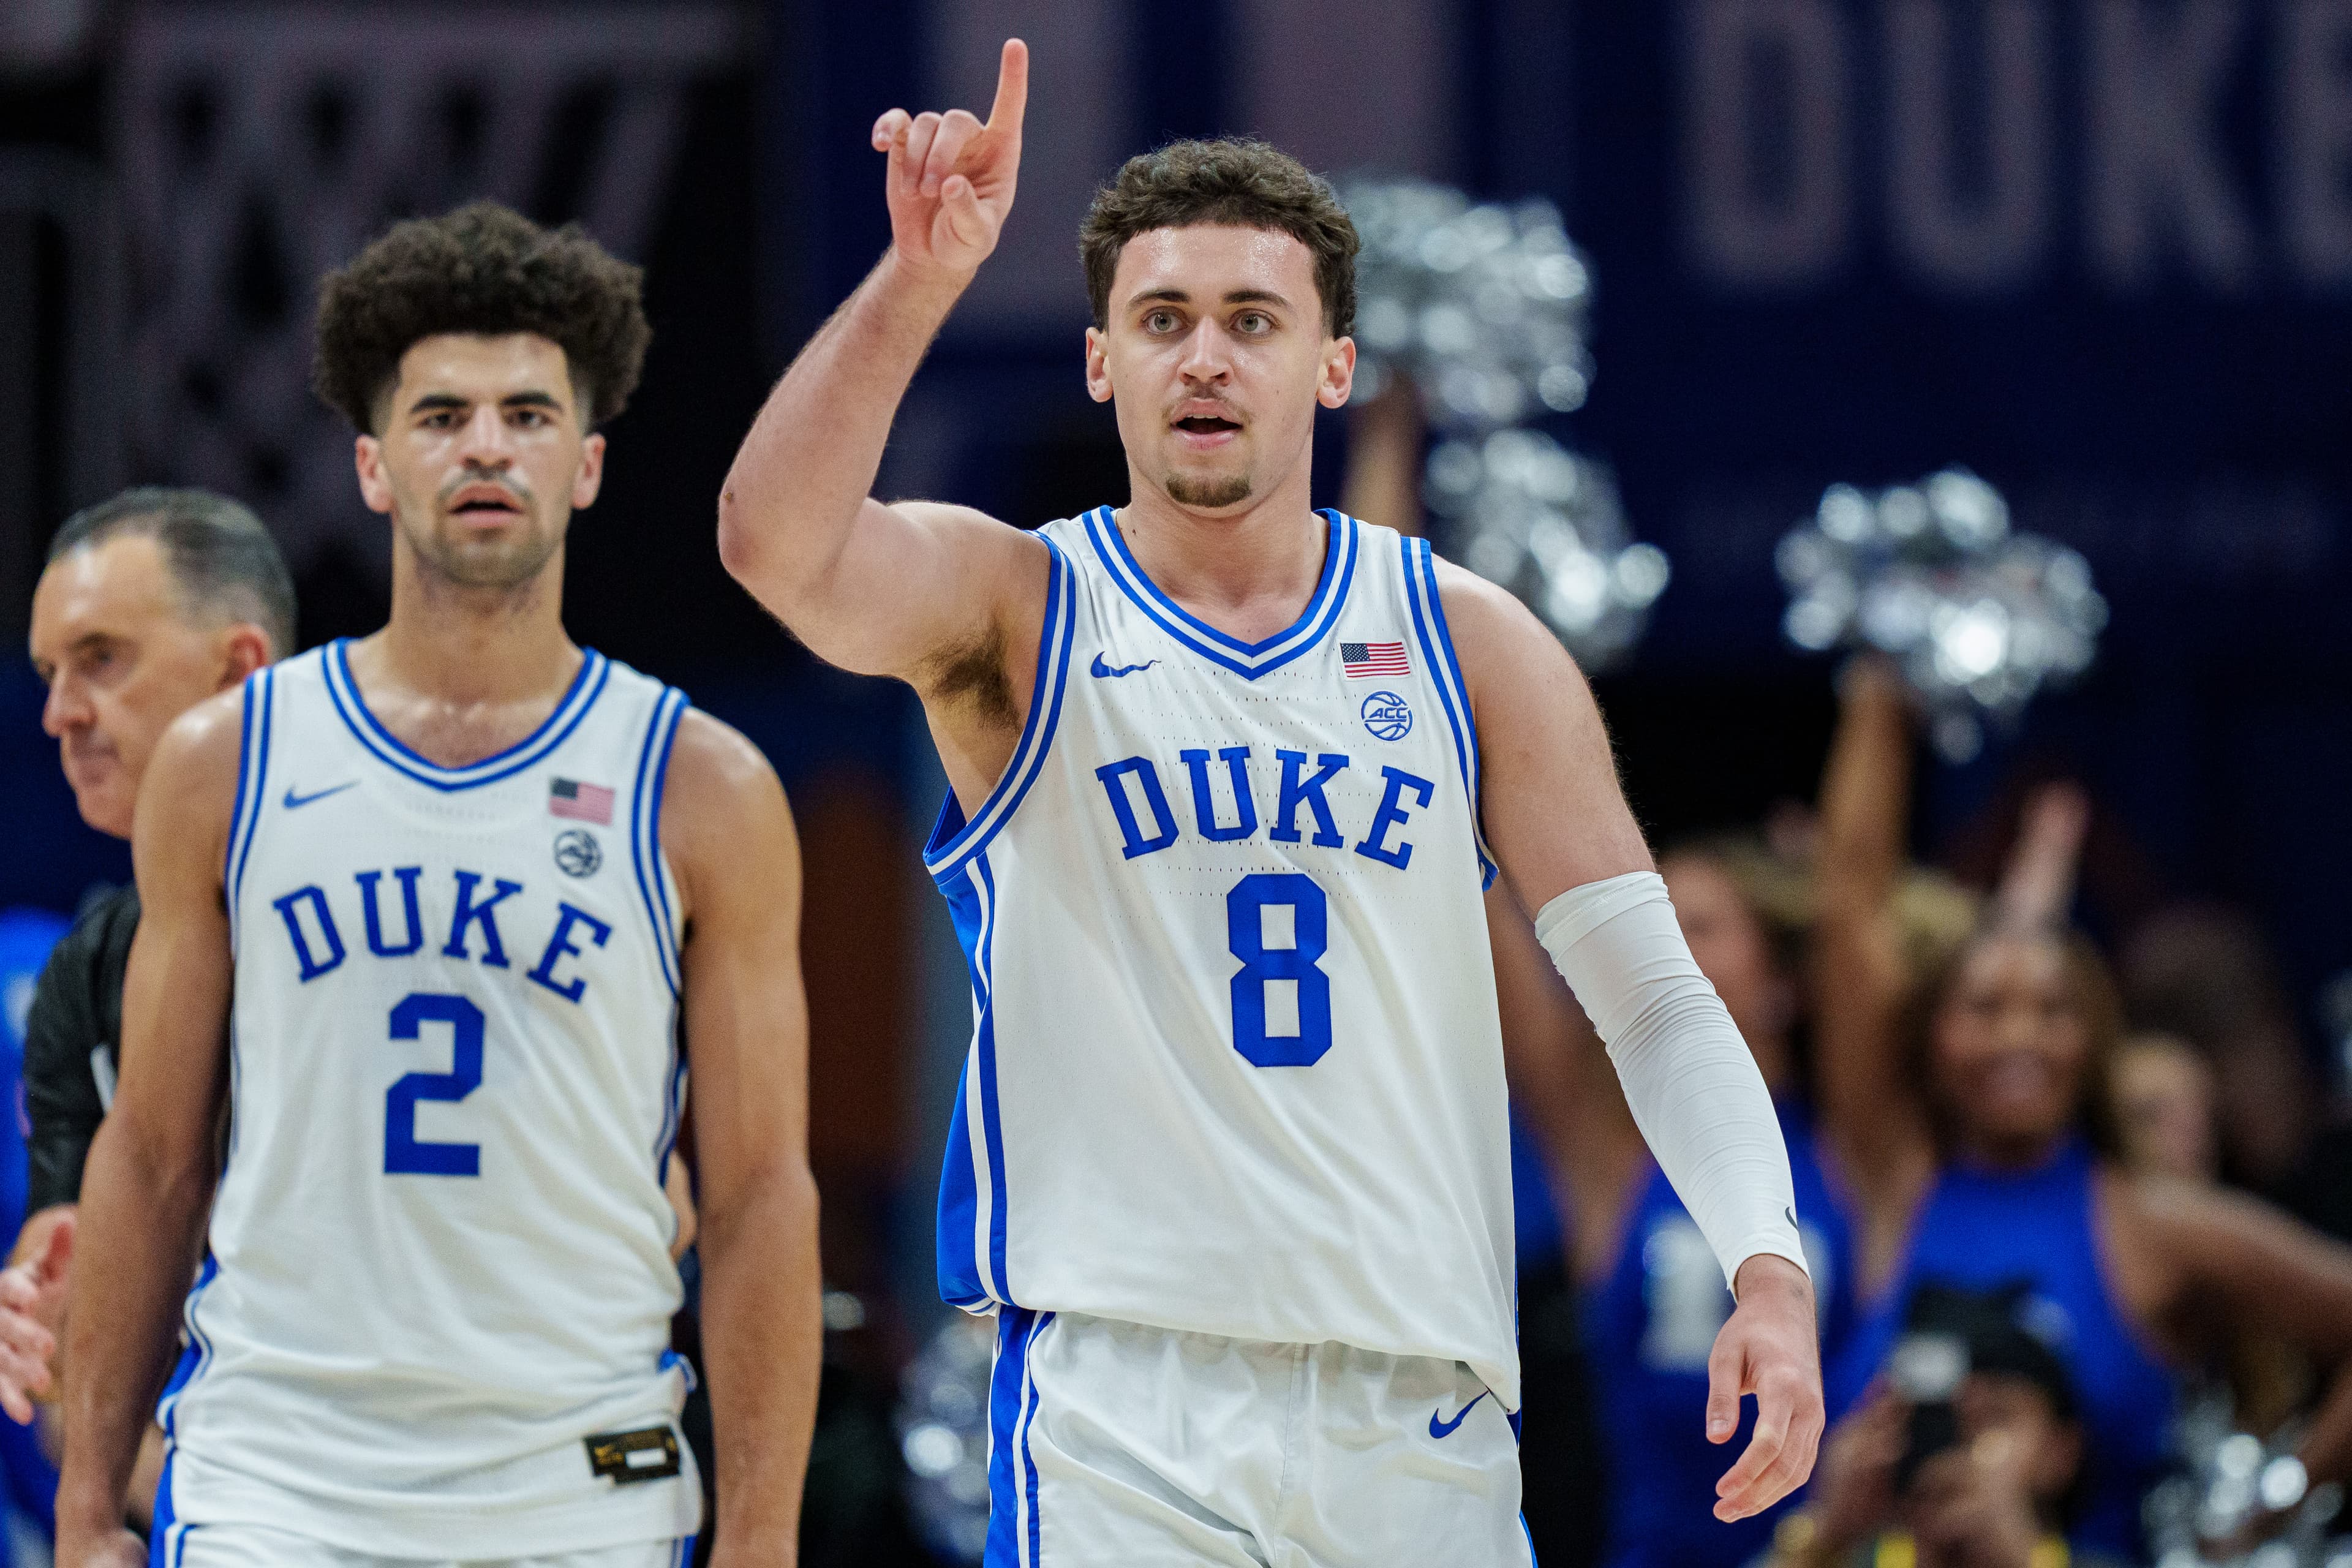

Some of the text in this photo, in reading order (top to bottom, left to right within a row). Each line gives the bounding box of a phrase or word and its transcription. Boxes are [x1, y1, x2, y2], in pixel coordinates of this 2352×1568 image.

[1369, 706, 1408, 719] ACC
[1095, 745, 1435, 870] DUKE
[272, 865, 612, 1003] DUKE
[1227, 873, 1332, 1068] 8
[383, 992, 485, 1177] 2
